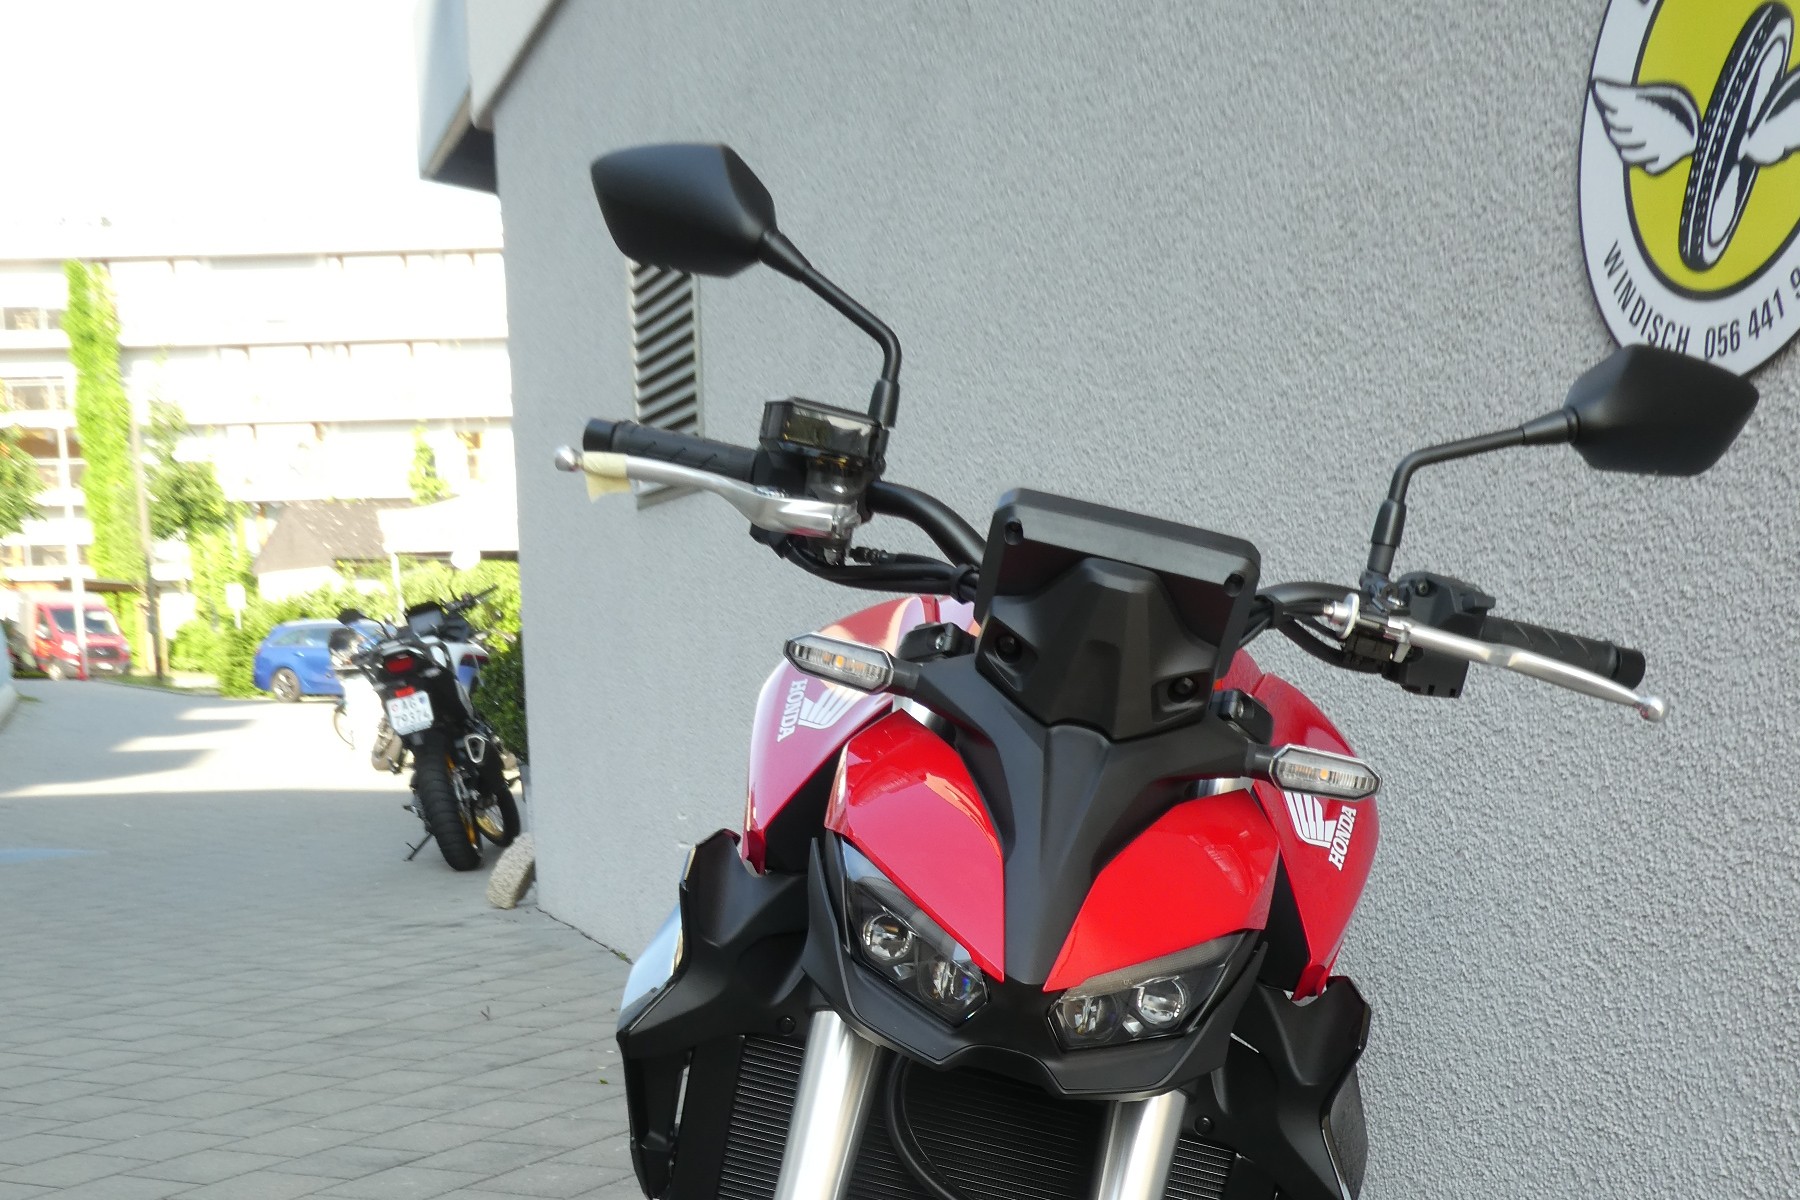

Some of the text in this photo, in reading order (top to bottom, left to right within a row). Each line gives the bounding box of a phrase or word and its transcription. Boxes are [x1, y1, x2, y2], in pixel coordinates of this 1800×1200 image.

[1603, 238, 1690, 354] WINDISCH
[1704, 318, 1741, 360] 056
[1748, 287, 1784, 339] 441
[777, 678, 808, 742] HONDA
[1328, 805, 1357, 871] HONDA
